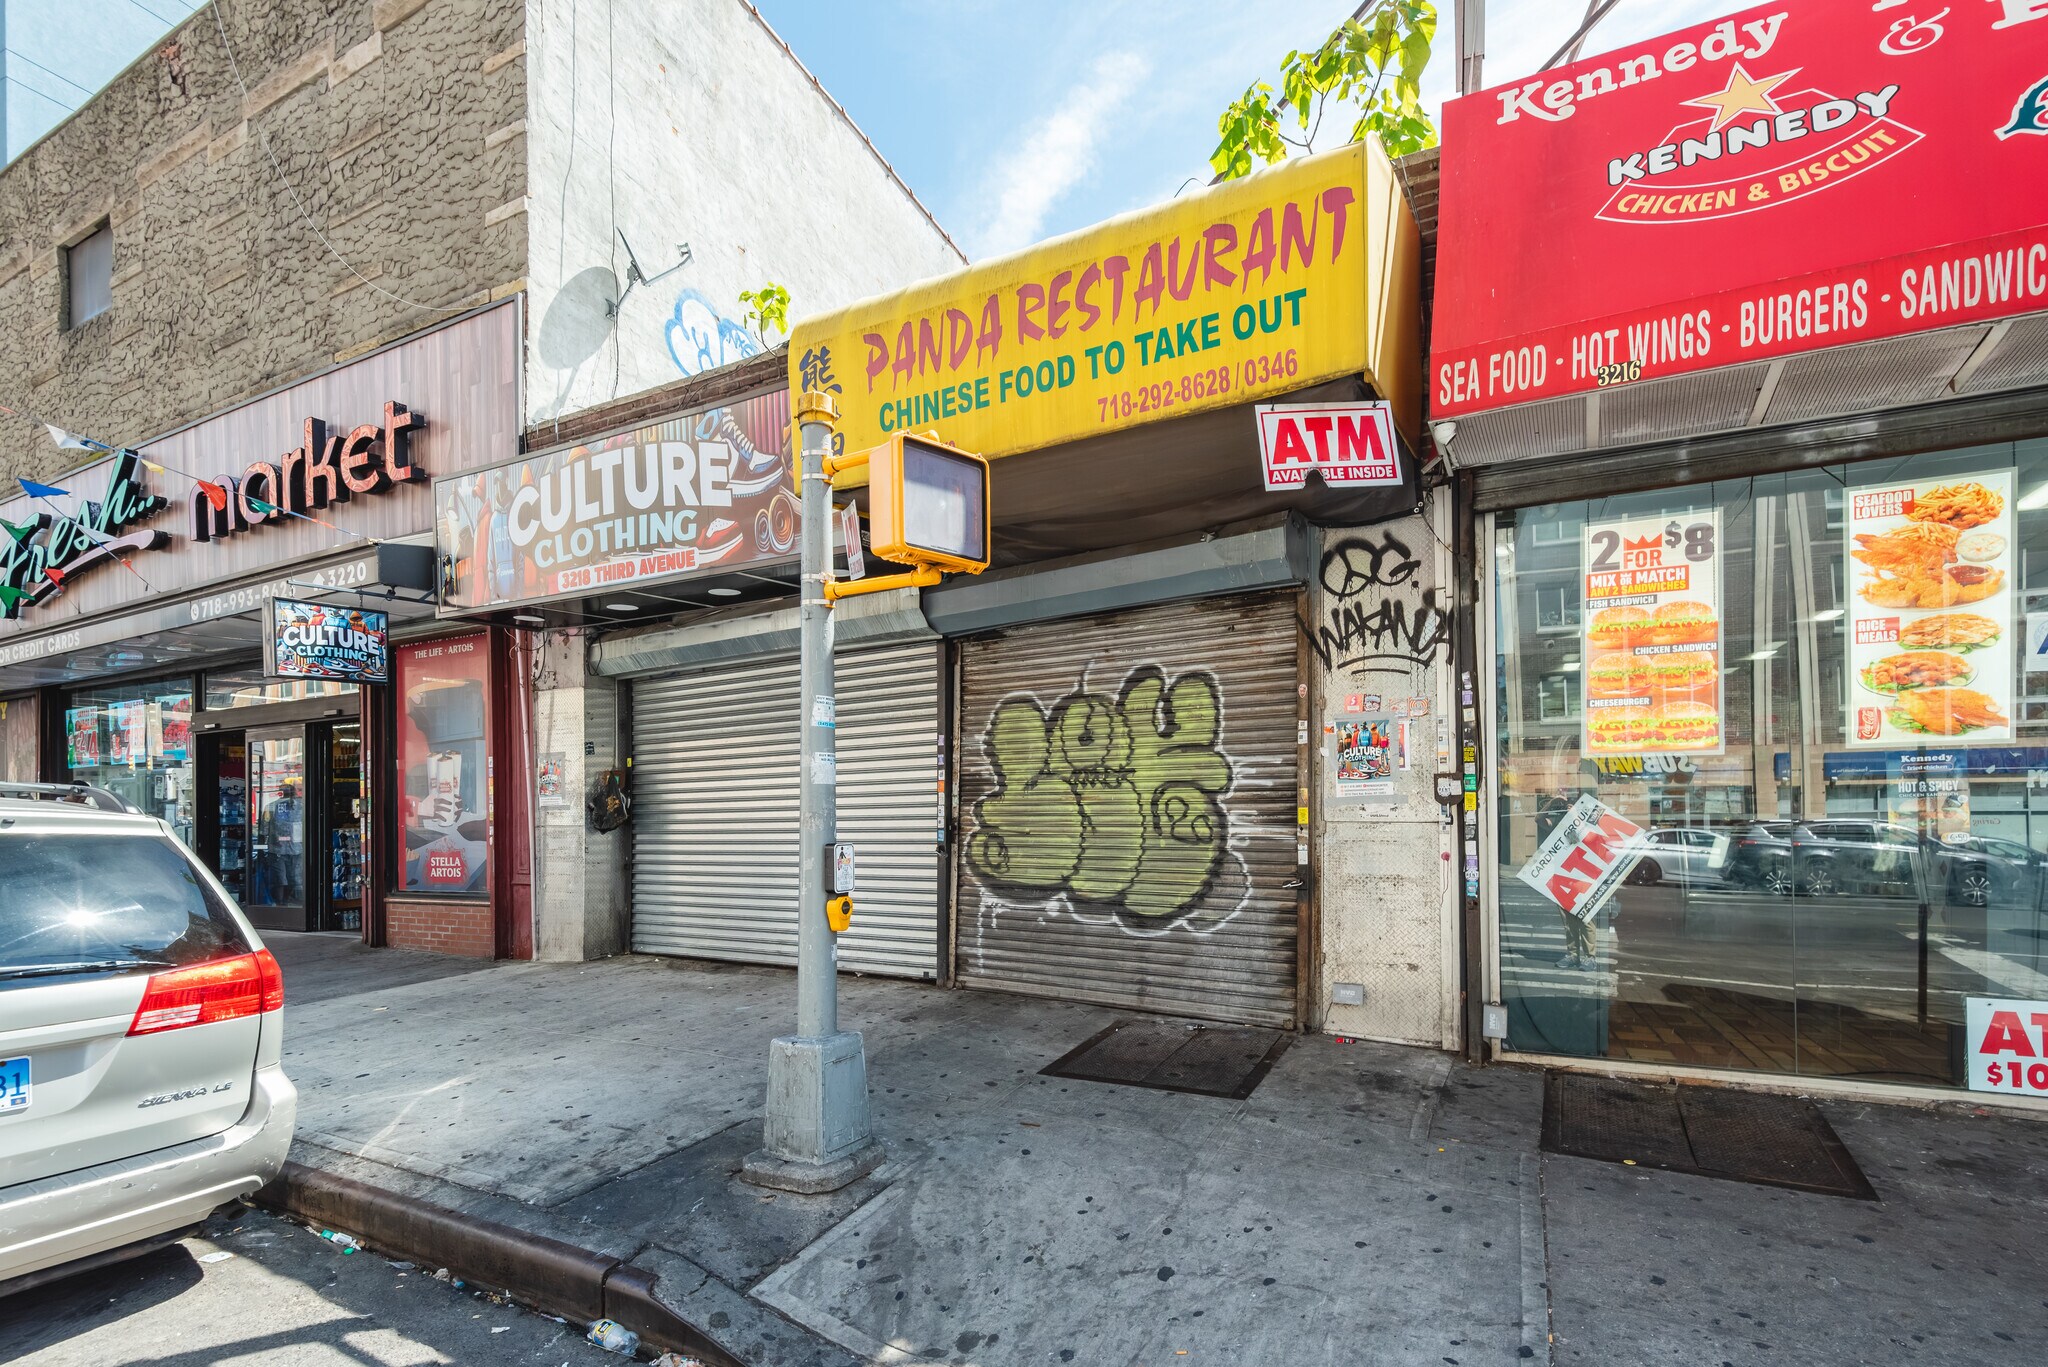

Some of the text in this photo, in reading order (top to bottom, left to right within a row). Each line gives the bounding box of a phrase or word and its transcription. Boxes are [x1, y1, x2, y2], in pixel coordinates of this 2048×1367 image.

[1879, 7, 1951, 56] &
[1496, 12, 1790, 126] Kennedy
[1608, 84, 1901, 187] KENNEDY
[1616, 129, 1897, 216] CHICKEN & BISCUIT
[863, 293, 1003, 394] PANDA
[1016, 186, 1356, 346] RESTAURANT
[1439, 243, 2047, 406] SEA FOOD HOT WINGS BURGERS SANDWIC
[879, 288, 1307, 433] CHINESE FOOD TO TAKE OUT
[1597, 359, 1641, 387] 3216
[1272, 415, 1386, 465] ATM
[189, 400, 420, 542] market
[1349, 466, 1393, 479] INSIDE
[507, 440, 733, 547] CULTURE
[1855, 489, 1913, 508] SEAFOOD
[1855, 503, 1904, 519] LOVERS
[534, 509, 698, 569] CLOTHING
[1591, 520, 1715, 573] 2 FOR $8
[328, 562, 367, 587] 3220
[561, 549, 697, 590] 3218 THIRD AVENUE
[1591, 567, 1686, 588] MIX OR MATCH
[1589, 595, 1654, 609] FISH SANDWICH
[1590, 580, 1686, 598] ANY 2 SANDWICHES
[1857, 619, 1886, 632] RICE
[1857, 629, 1898, 643] MEALS
[12, 640, 45, 660] CREDIT
[47, 631, 81, 653] CARDS
[282, 625, 380, 656] CULTURE
[296, 645, 368, 662] CLOTHING
[414, 642, 474, 659] THE LIFE ARTOIS
[1635, 642, 1717, 656] CHICKEN SANDWICH
[1589, 697, 1650, 708] CHEESEBURGER
[1343, 746, 1381, 758] CULTURE
[1900, 753, 1953, 763] Kennedy
[1897, 780, 1959, 793] HOT & SPICY
[430, 856, 461, 867] STELLA
[1531, 836, 1566, 879] CARDNET
[1545, 813, 1641, 914] ATM
[430, 867, 462, 878] ARTOIS
[138, 1081, 234, 1109] SIENNA LE
